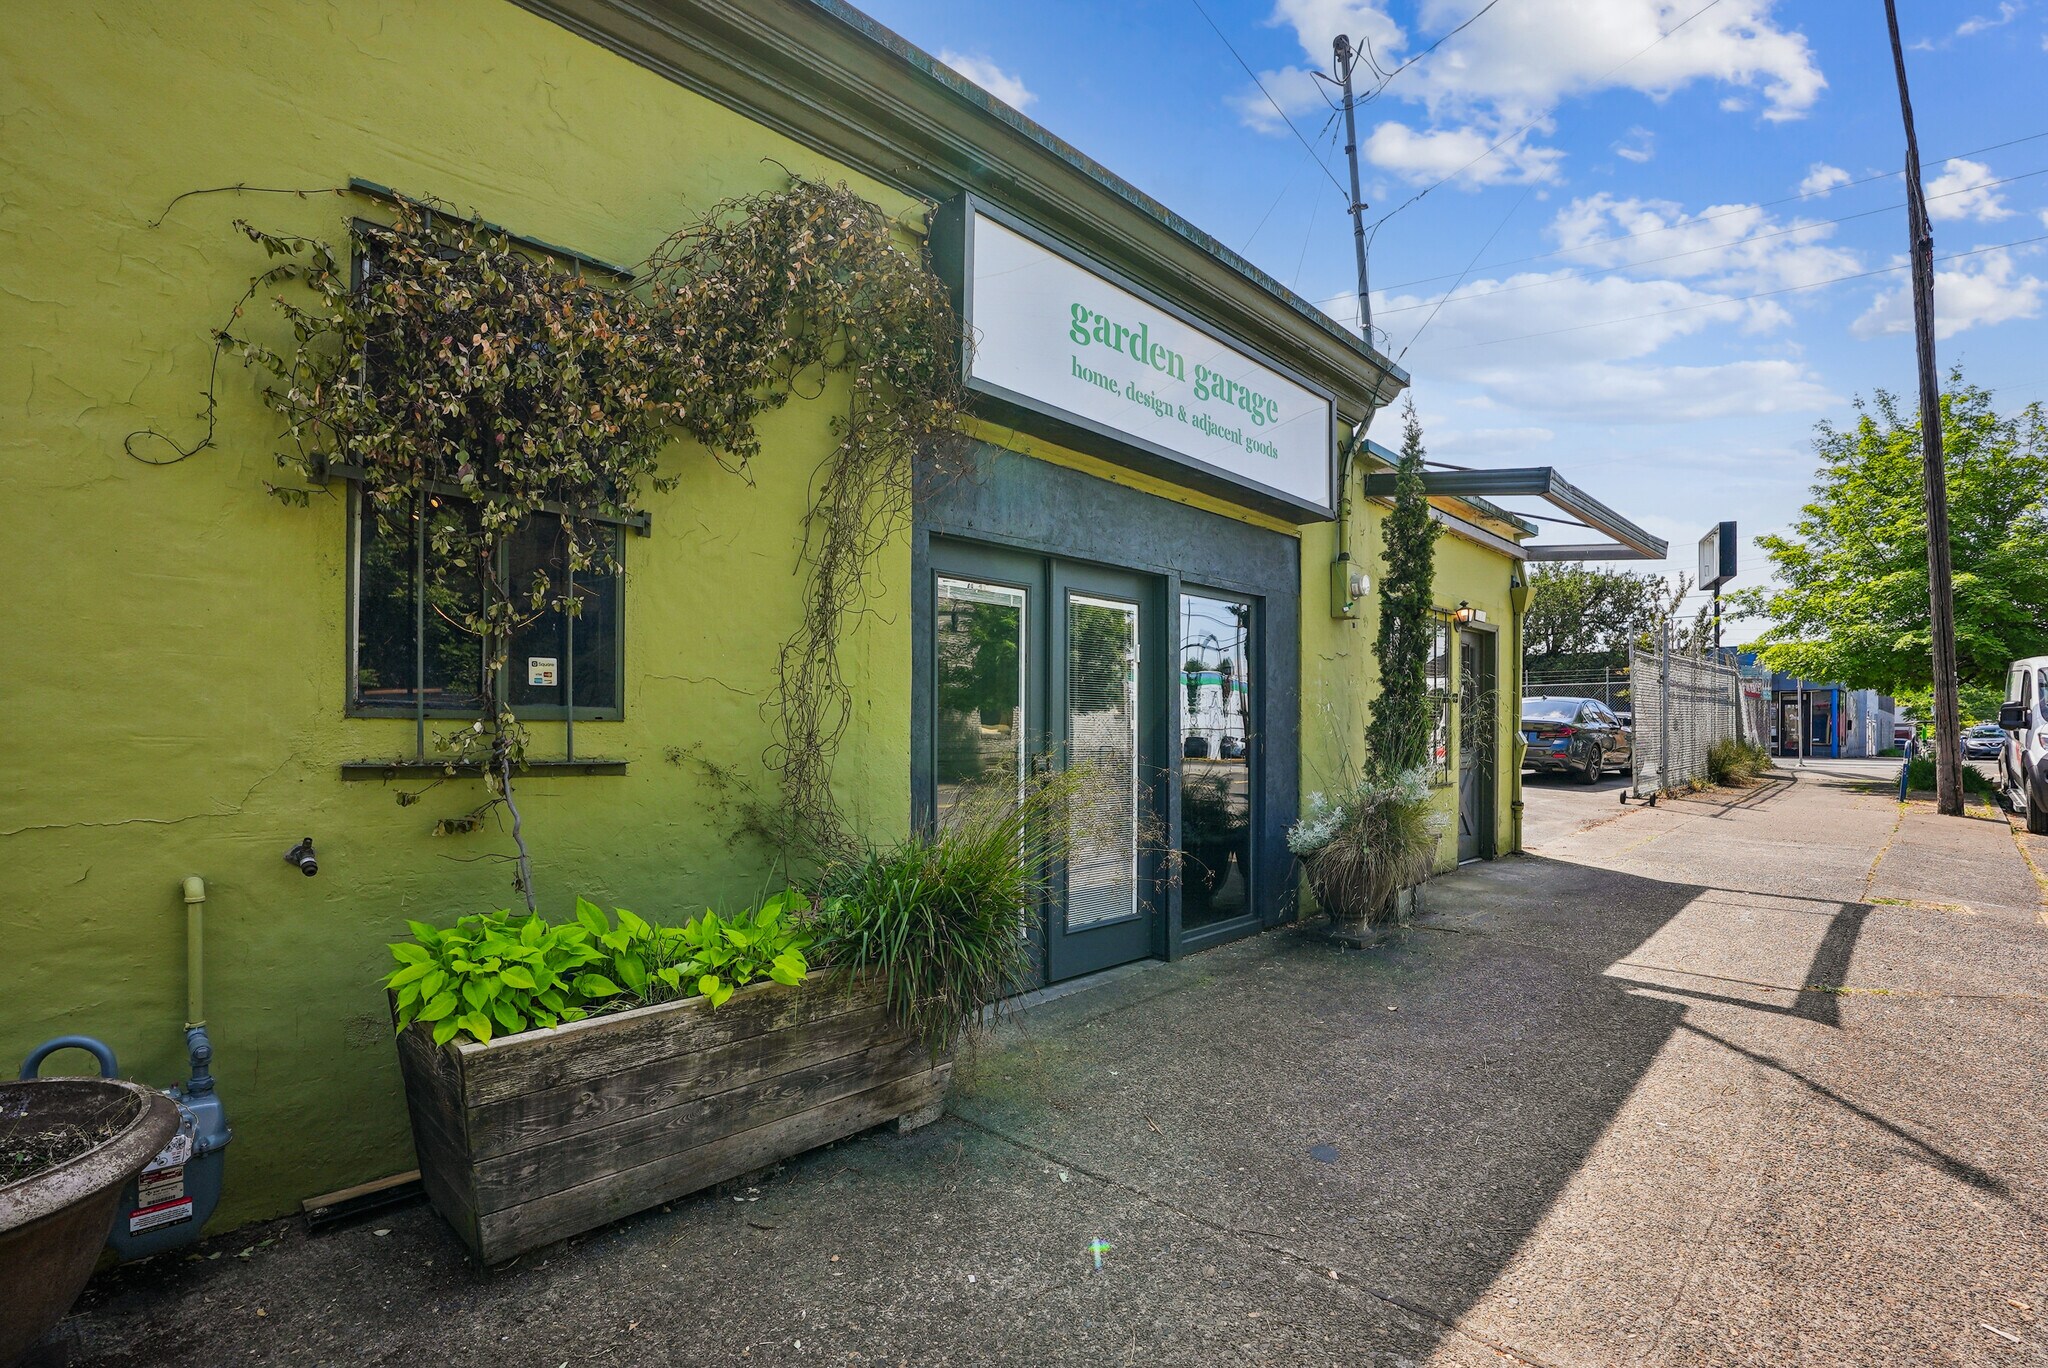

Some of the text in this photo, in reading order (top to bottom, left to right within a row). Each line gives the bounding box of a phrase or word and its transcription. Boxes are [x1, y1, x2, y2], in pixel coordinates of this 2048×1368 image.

[1070, 303, 1278, 426] garden garage
[1072, 355, 1278, 459] home, design & adjacent goods
